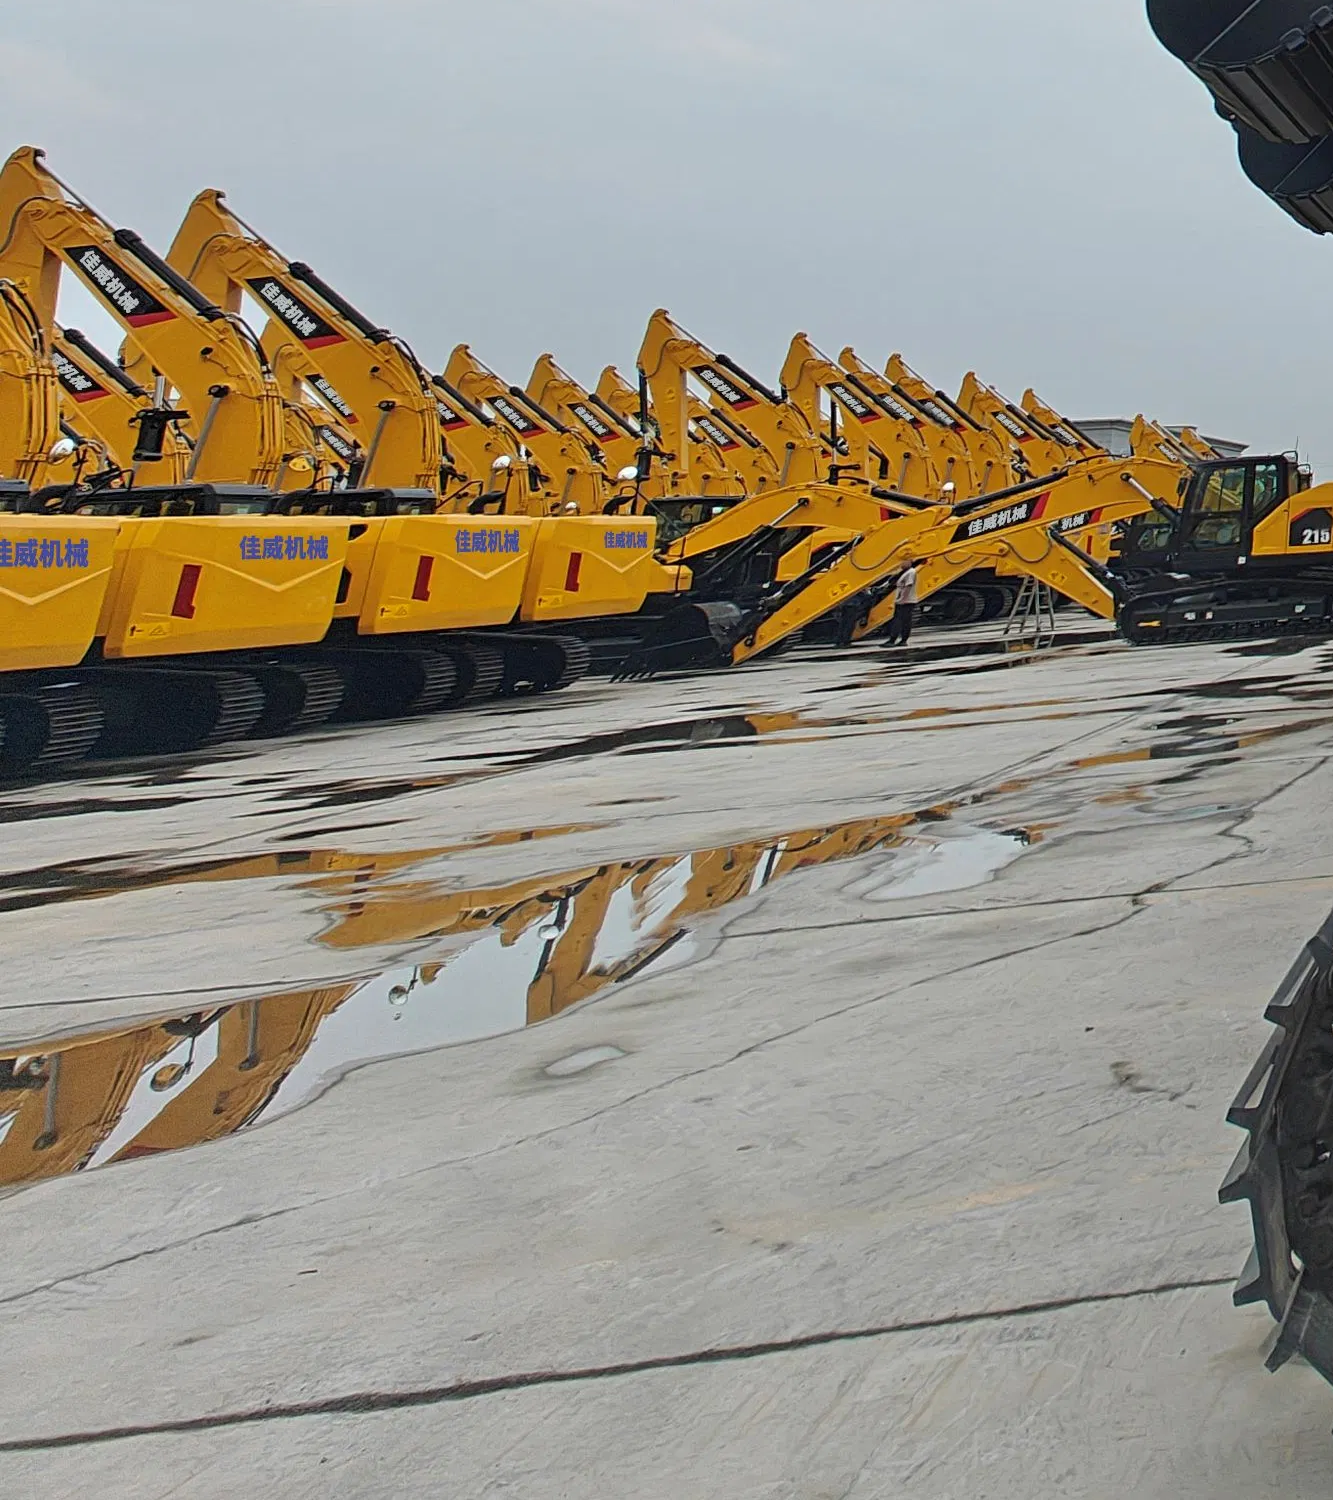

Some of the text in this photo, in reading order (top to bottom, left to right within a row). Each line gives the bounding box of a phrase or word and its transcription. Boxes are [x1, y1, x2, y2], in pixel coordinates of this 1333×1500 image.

[79, 250, 140, 314] 佳威机械
[259, 282, 318, 337] 佳威机械
[967, 503, 1028, 537] 佳威机械
[239, 535, 328, 561] 佳威机械
[454, 529, 520, 553] 佳威机械
[604, 531, 648, 549] 佳威机械
[1302, 528, 1331, 545] 215
